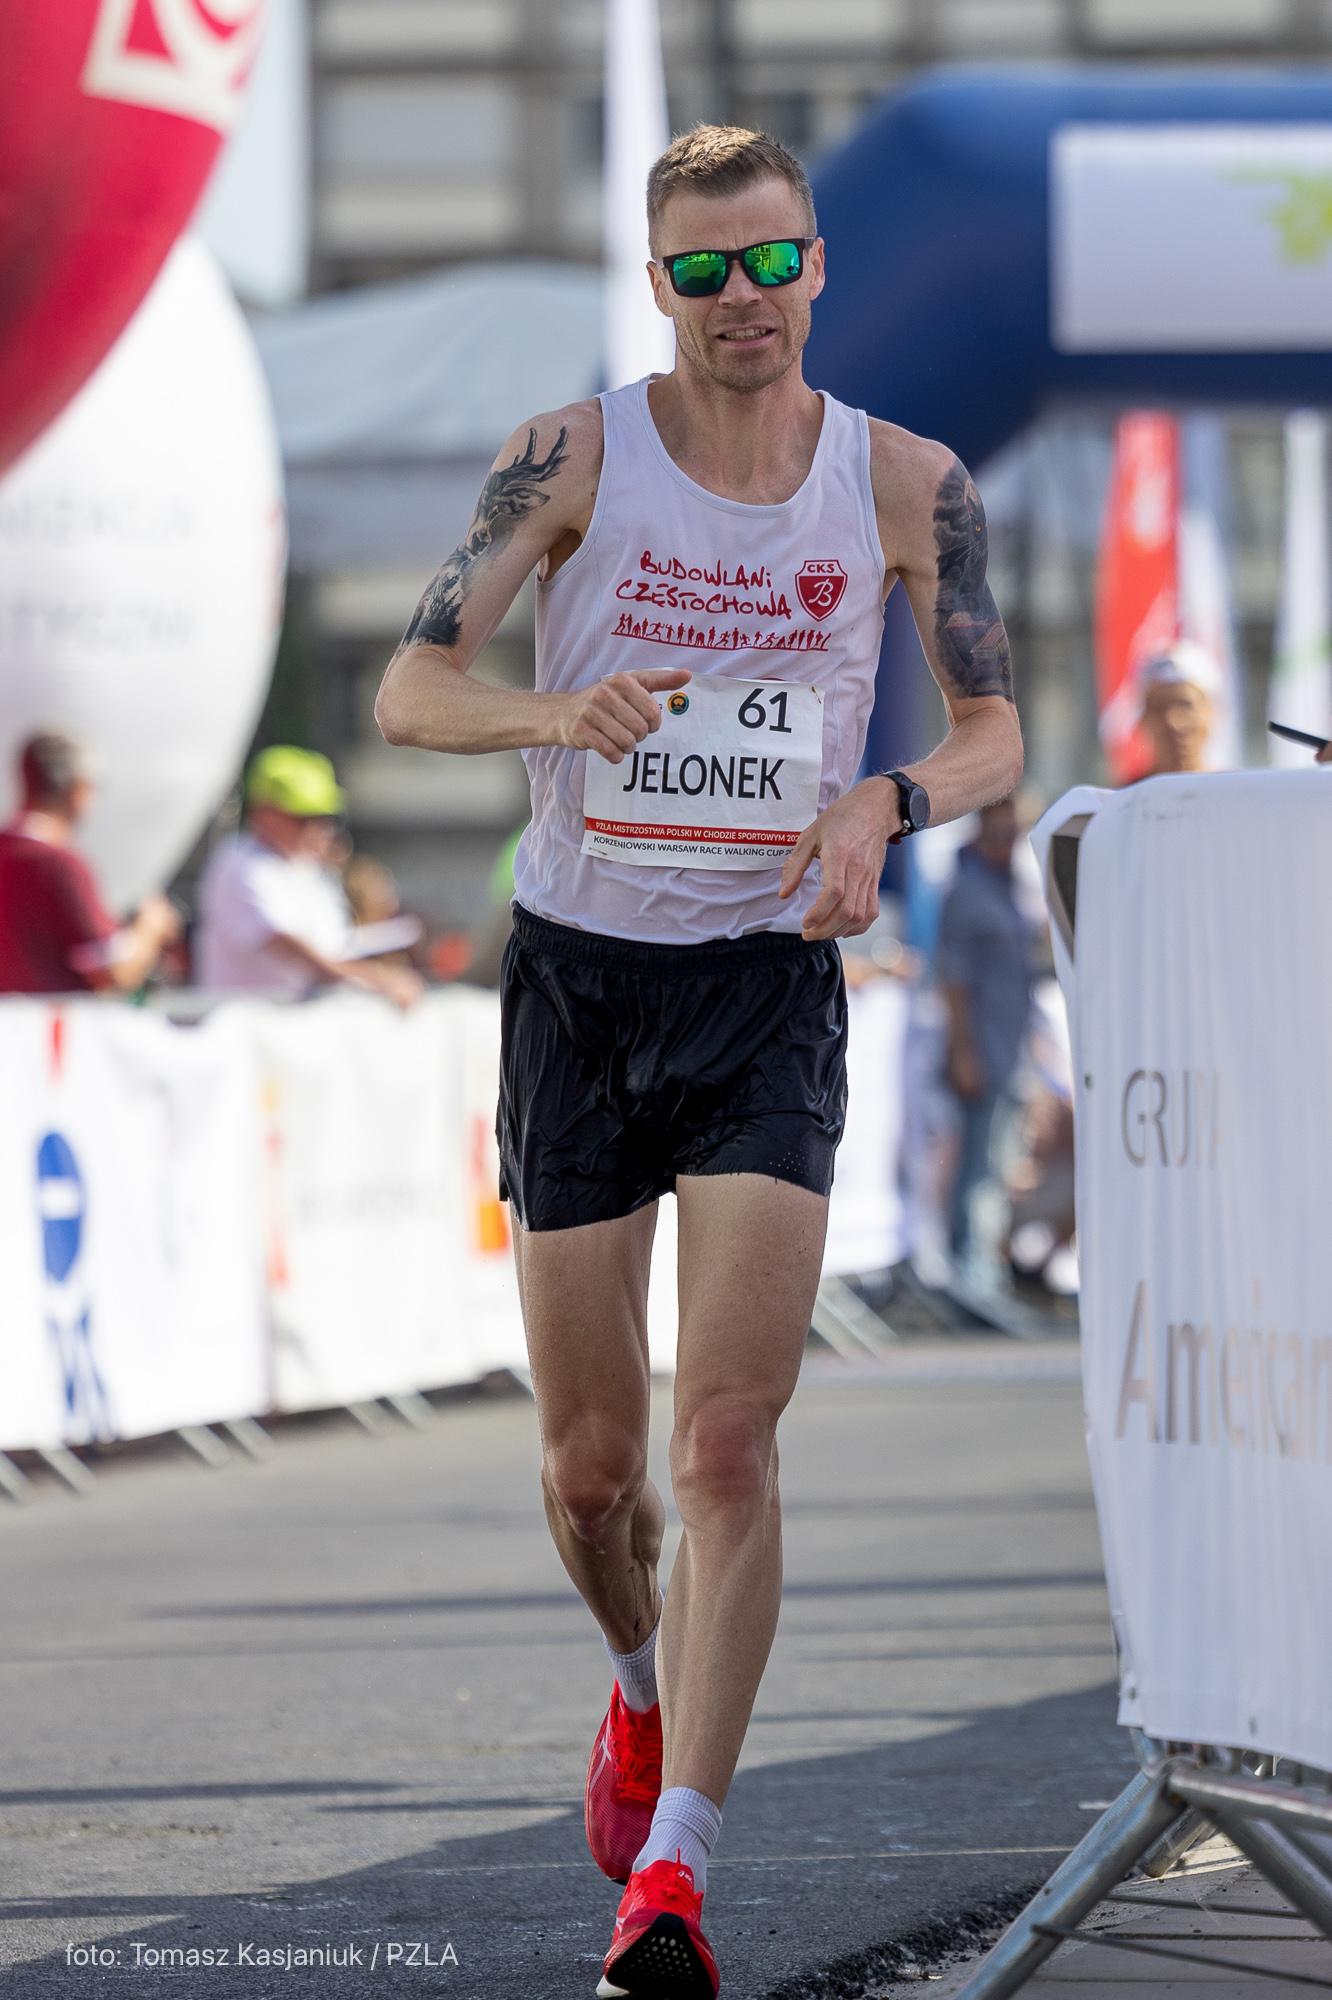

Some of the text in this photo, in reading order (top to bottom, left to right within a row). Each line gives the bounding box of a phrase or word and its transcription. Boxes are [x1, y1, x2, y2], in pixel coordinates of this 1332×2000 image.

[806, 563, 835, 573] CKS
[808, 578, 834, 606] B
[738, 688, 792, 733] 61
[623, 751, 785, 800] JELONEK
[595, 822, 800, 843] PZLA MISTRZOSTWA POLSKI W CHODZIE SPORTOWYM 202
[593, 835, 656, 851] KORZENIOWSKI
[657, 843, 698, 853] WARSAW
[699, 846, 722, 855] RACE
[724, 847, 765, 857] WALKING
[766, 849, 785, 857] CUP
